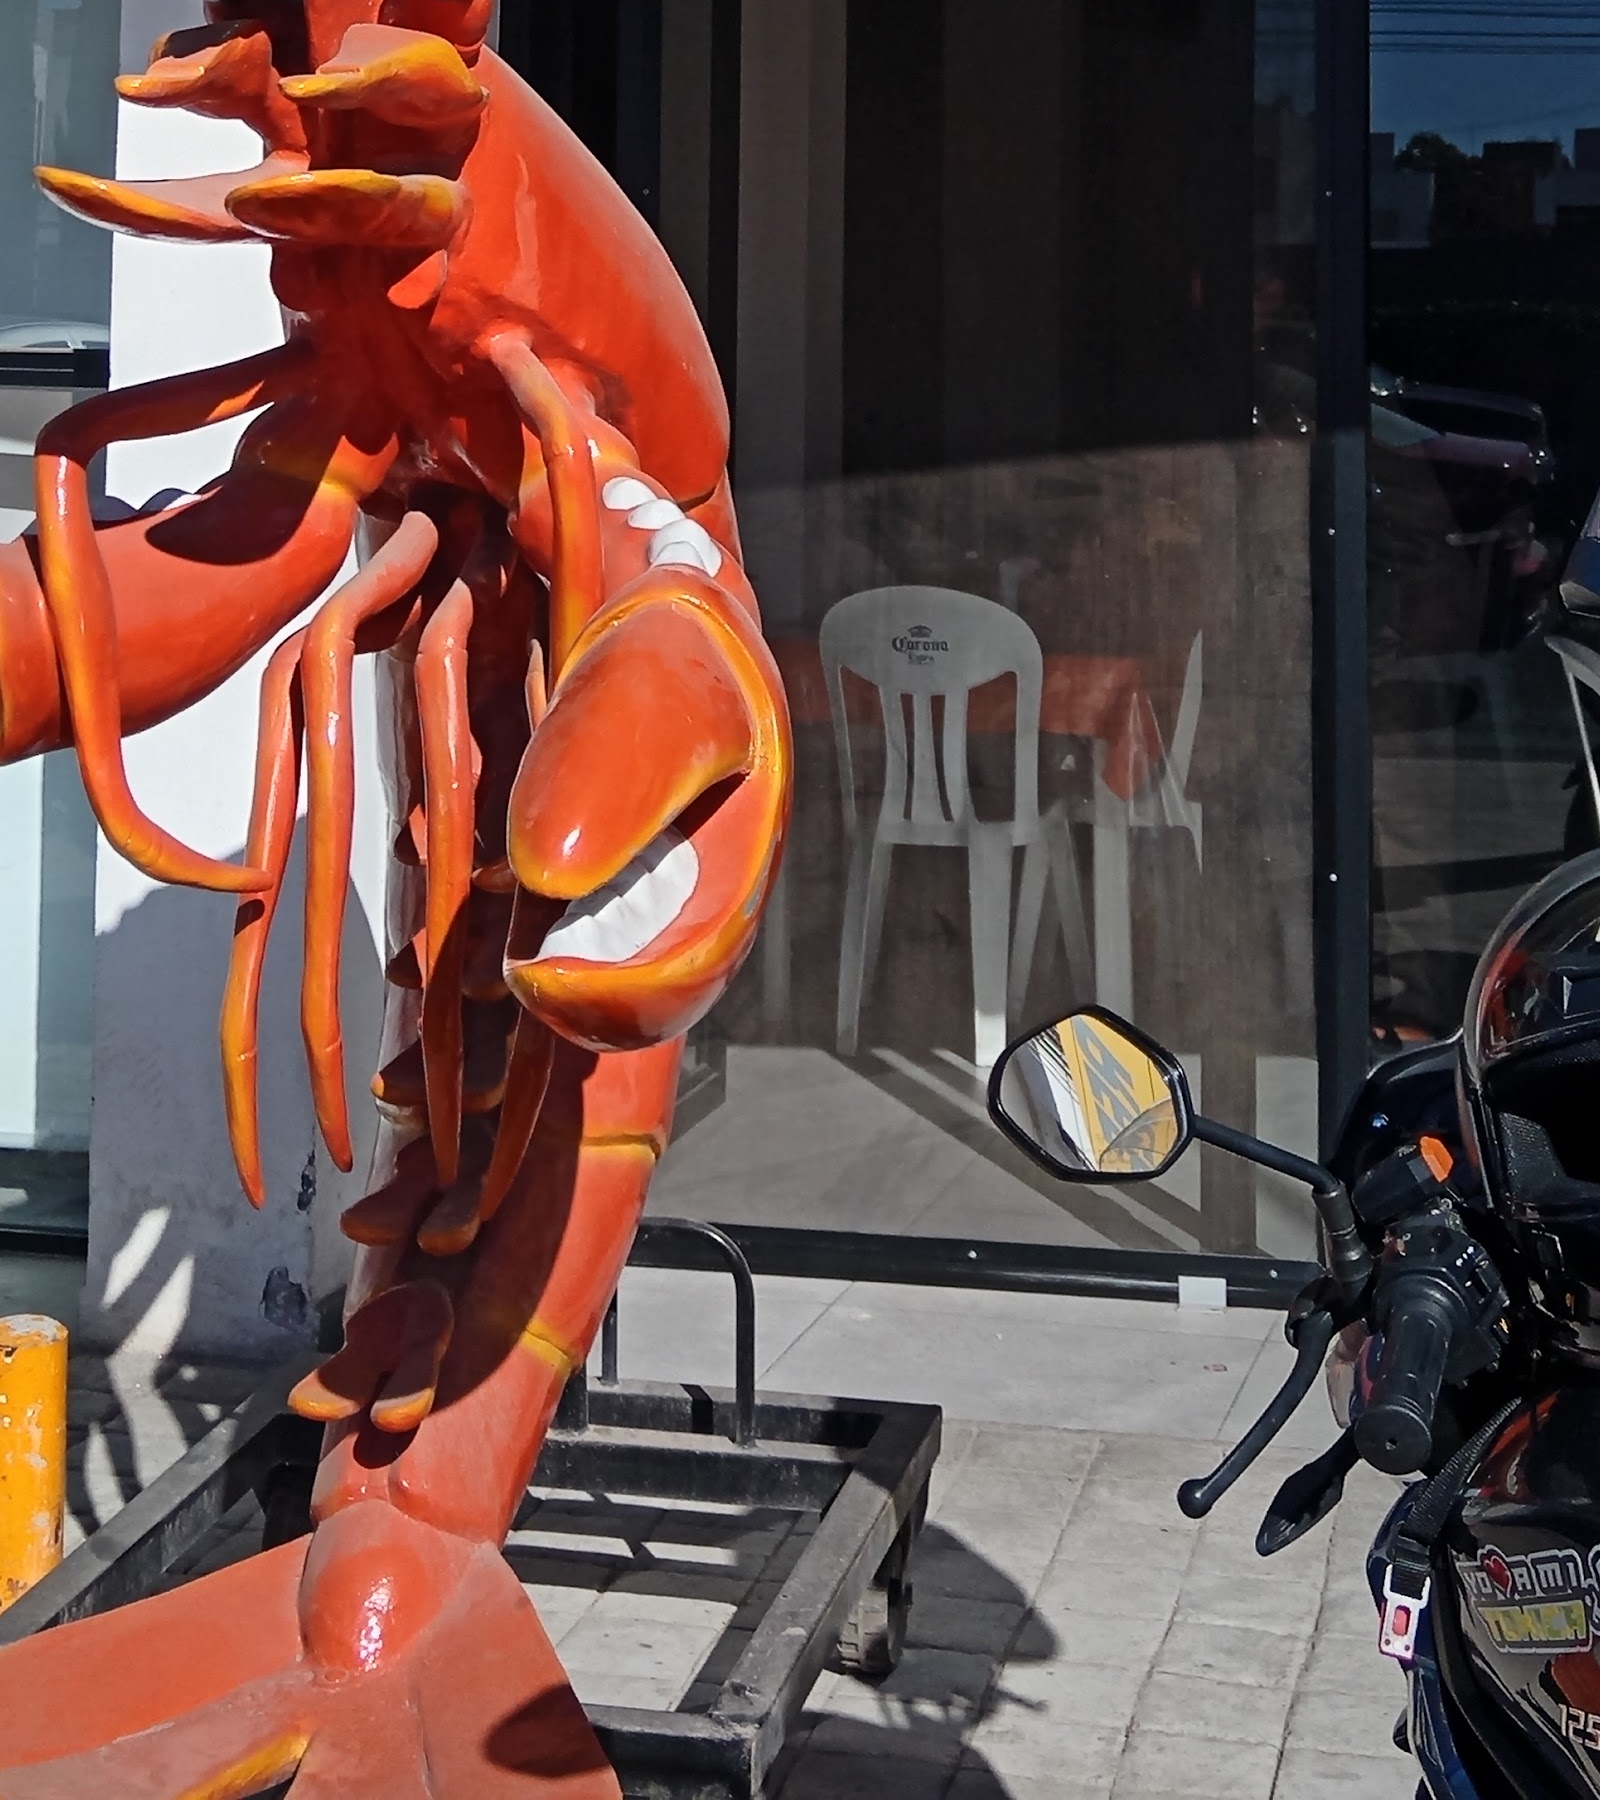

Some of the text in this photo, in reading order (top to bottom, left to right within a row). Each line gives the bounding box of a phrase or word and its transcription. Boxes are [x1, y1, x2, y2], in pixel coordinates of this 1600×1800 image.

[892, 636, 949, 653] Corona
[1464, 1562, 1577, 1594] YO A MI
